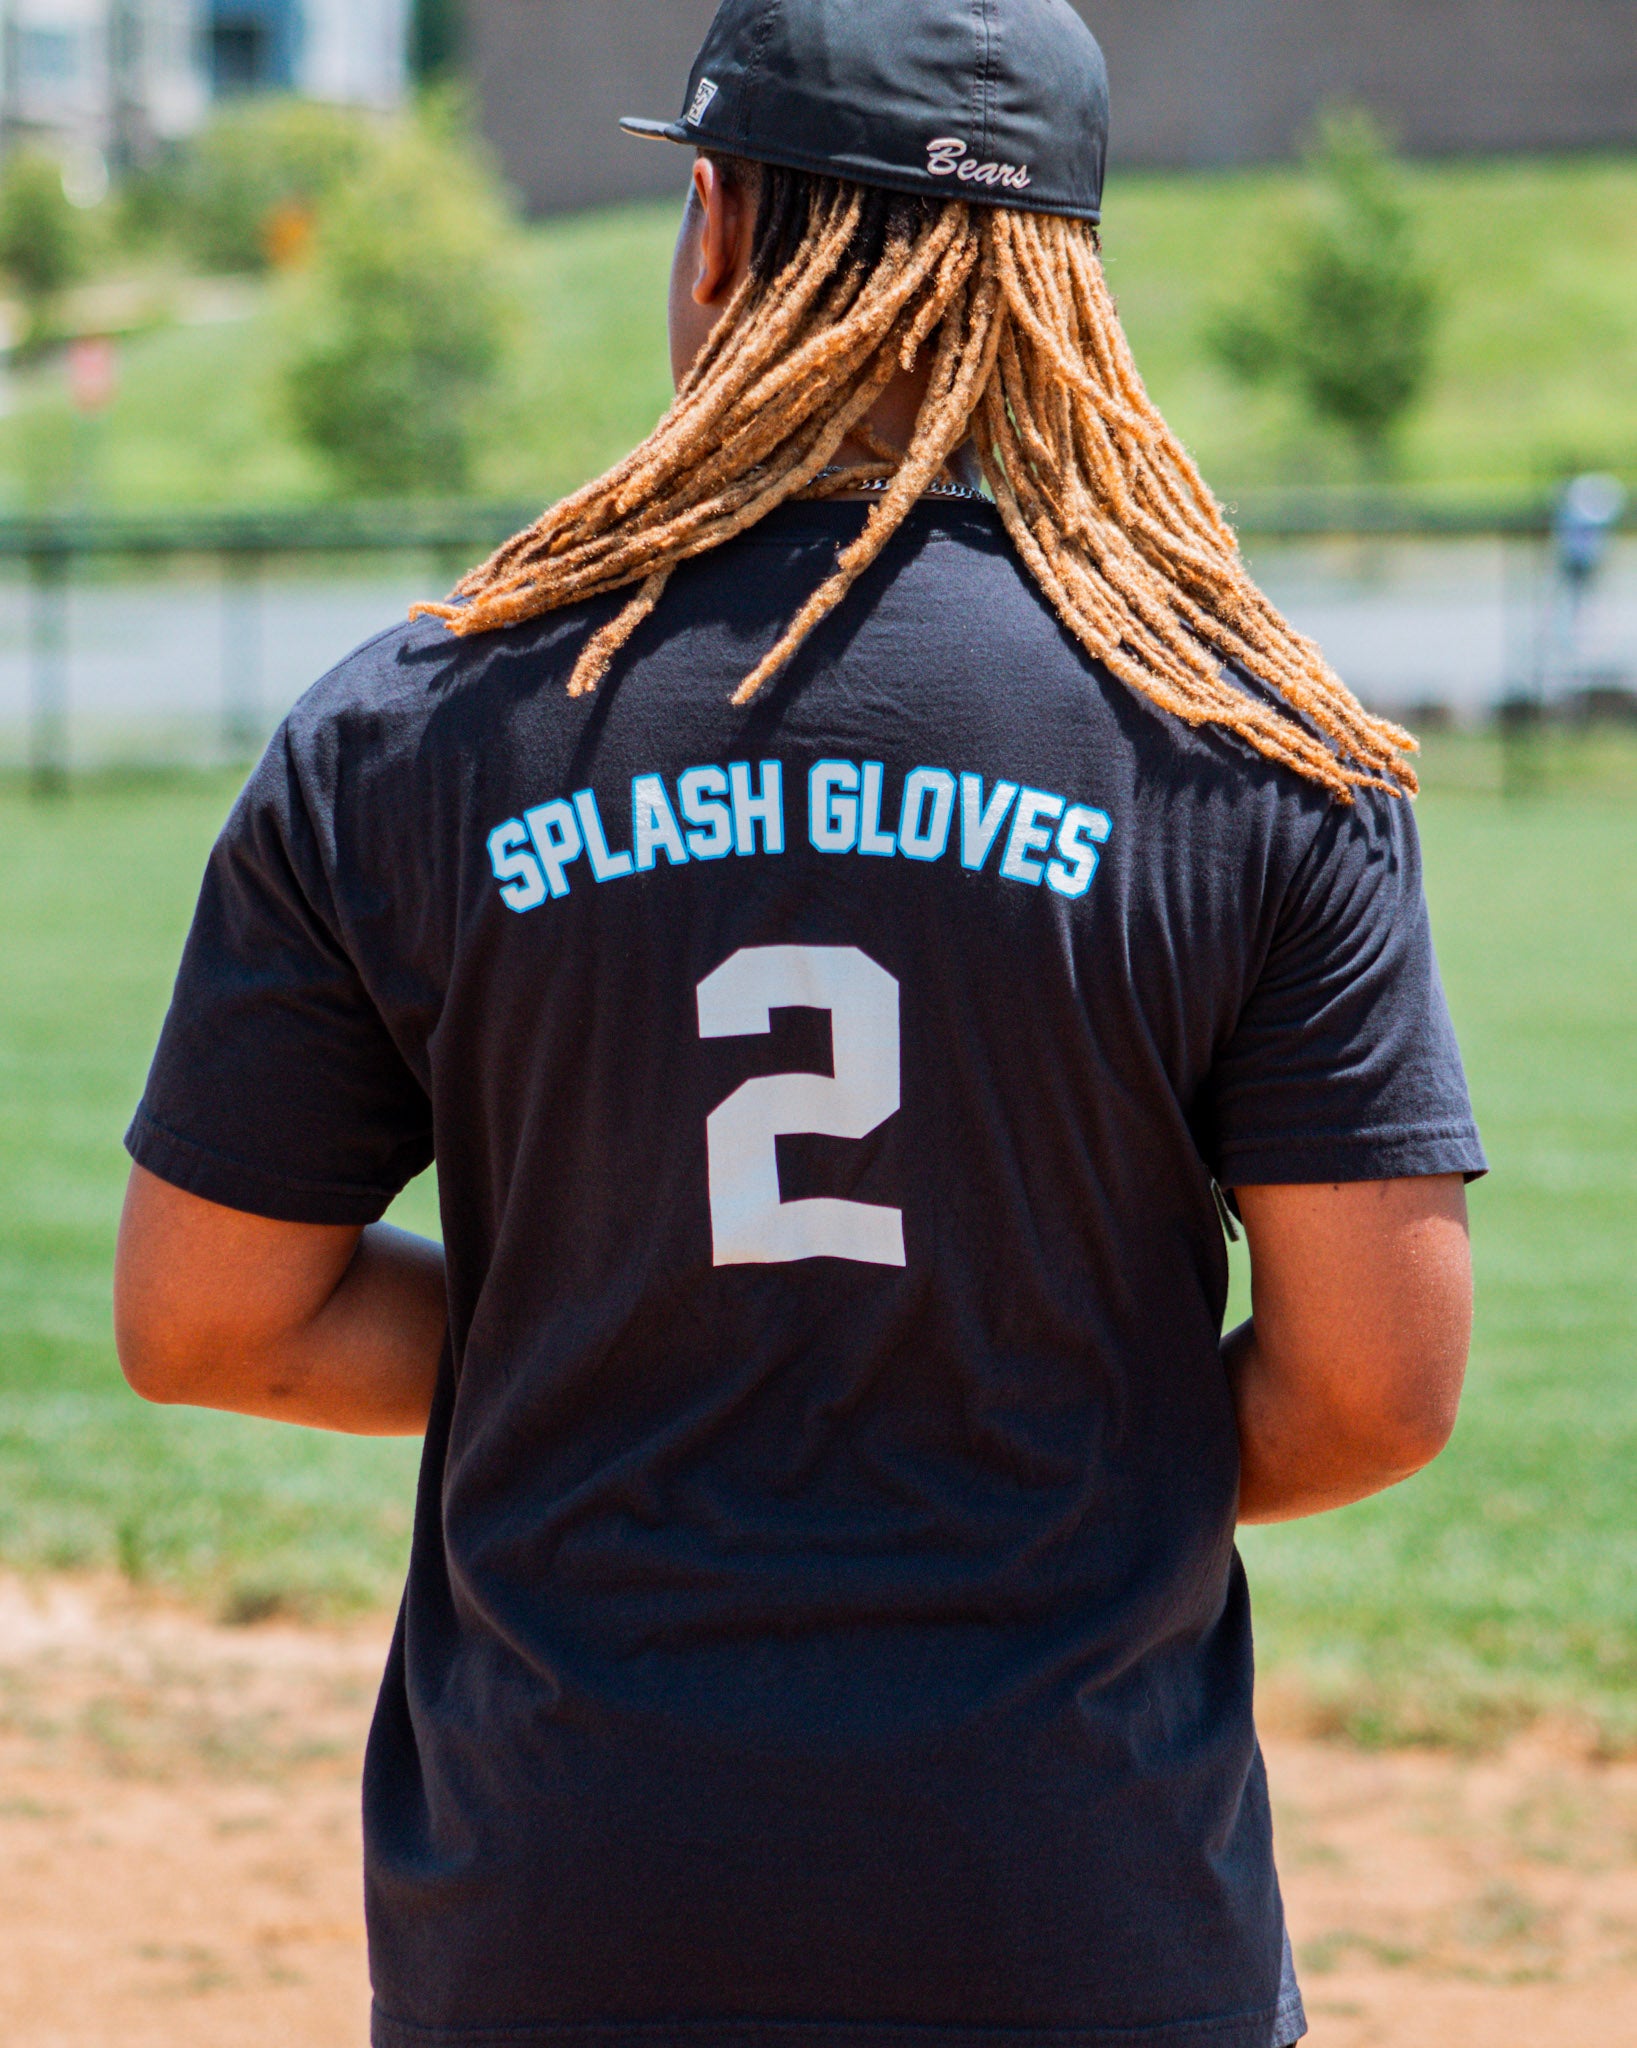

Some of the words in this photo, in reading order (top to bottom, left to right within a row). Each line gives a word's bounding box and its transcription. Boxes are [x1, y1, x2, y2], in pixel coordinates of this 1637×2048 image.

[926, 137, 1031, 189] Bears
[487, 760, 784, 913] SPLASH
[808, 760, 1112, 899] GLOVES
[696, 945, 907, 1267] 2
